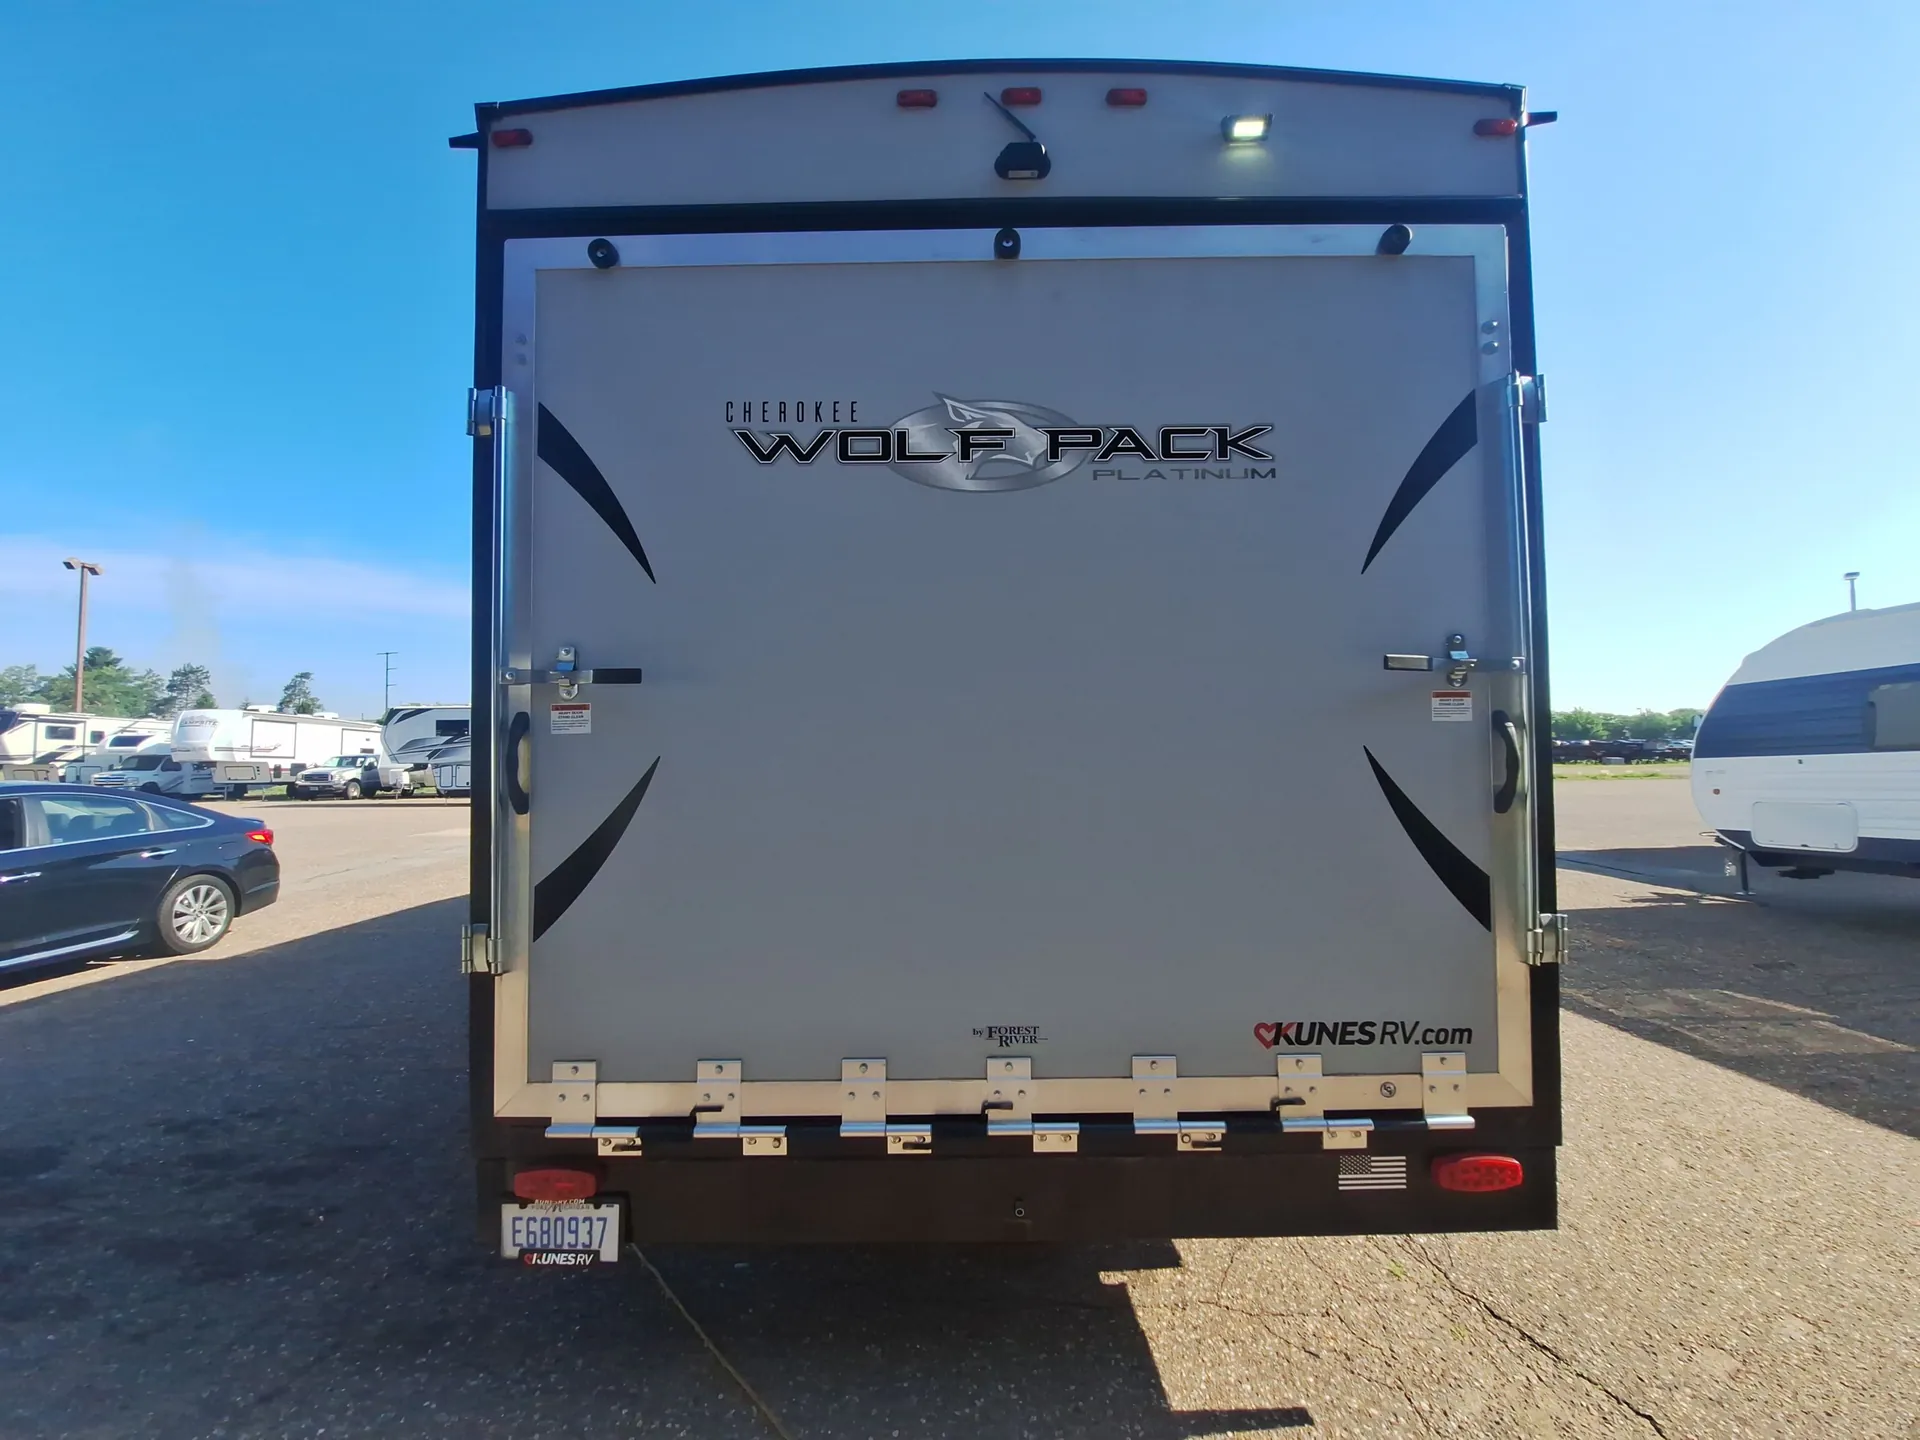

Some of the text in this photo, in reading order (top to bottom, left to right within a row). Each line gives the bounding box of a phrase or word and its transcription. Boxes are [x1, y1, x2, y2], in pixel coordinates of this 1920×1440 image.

[725, 400, 859, 423] CHEROKEE
[732, 425, 1275, 465] WOLF PACK
[1092, 466, 1277, 482] PLATINUM
[972, 1026, 1040, 1039] by FOREST
[998, 1035, 1039, 1048] RIVER
[511, 1216, 608, 1249] E680937
